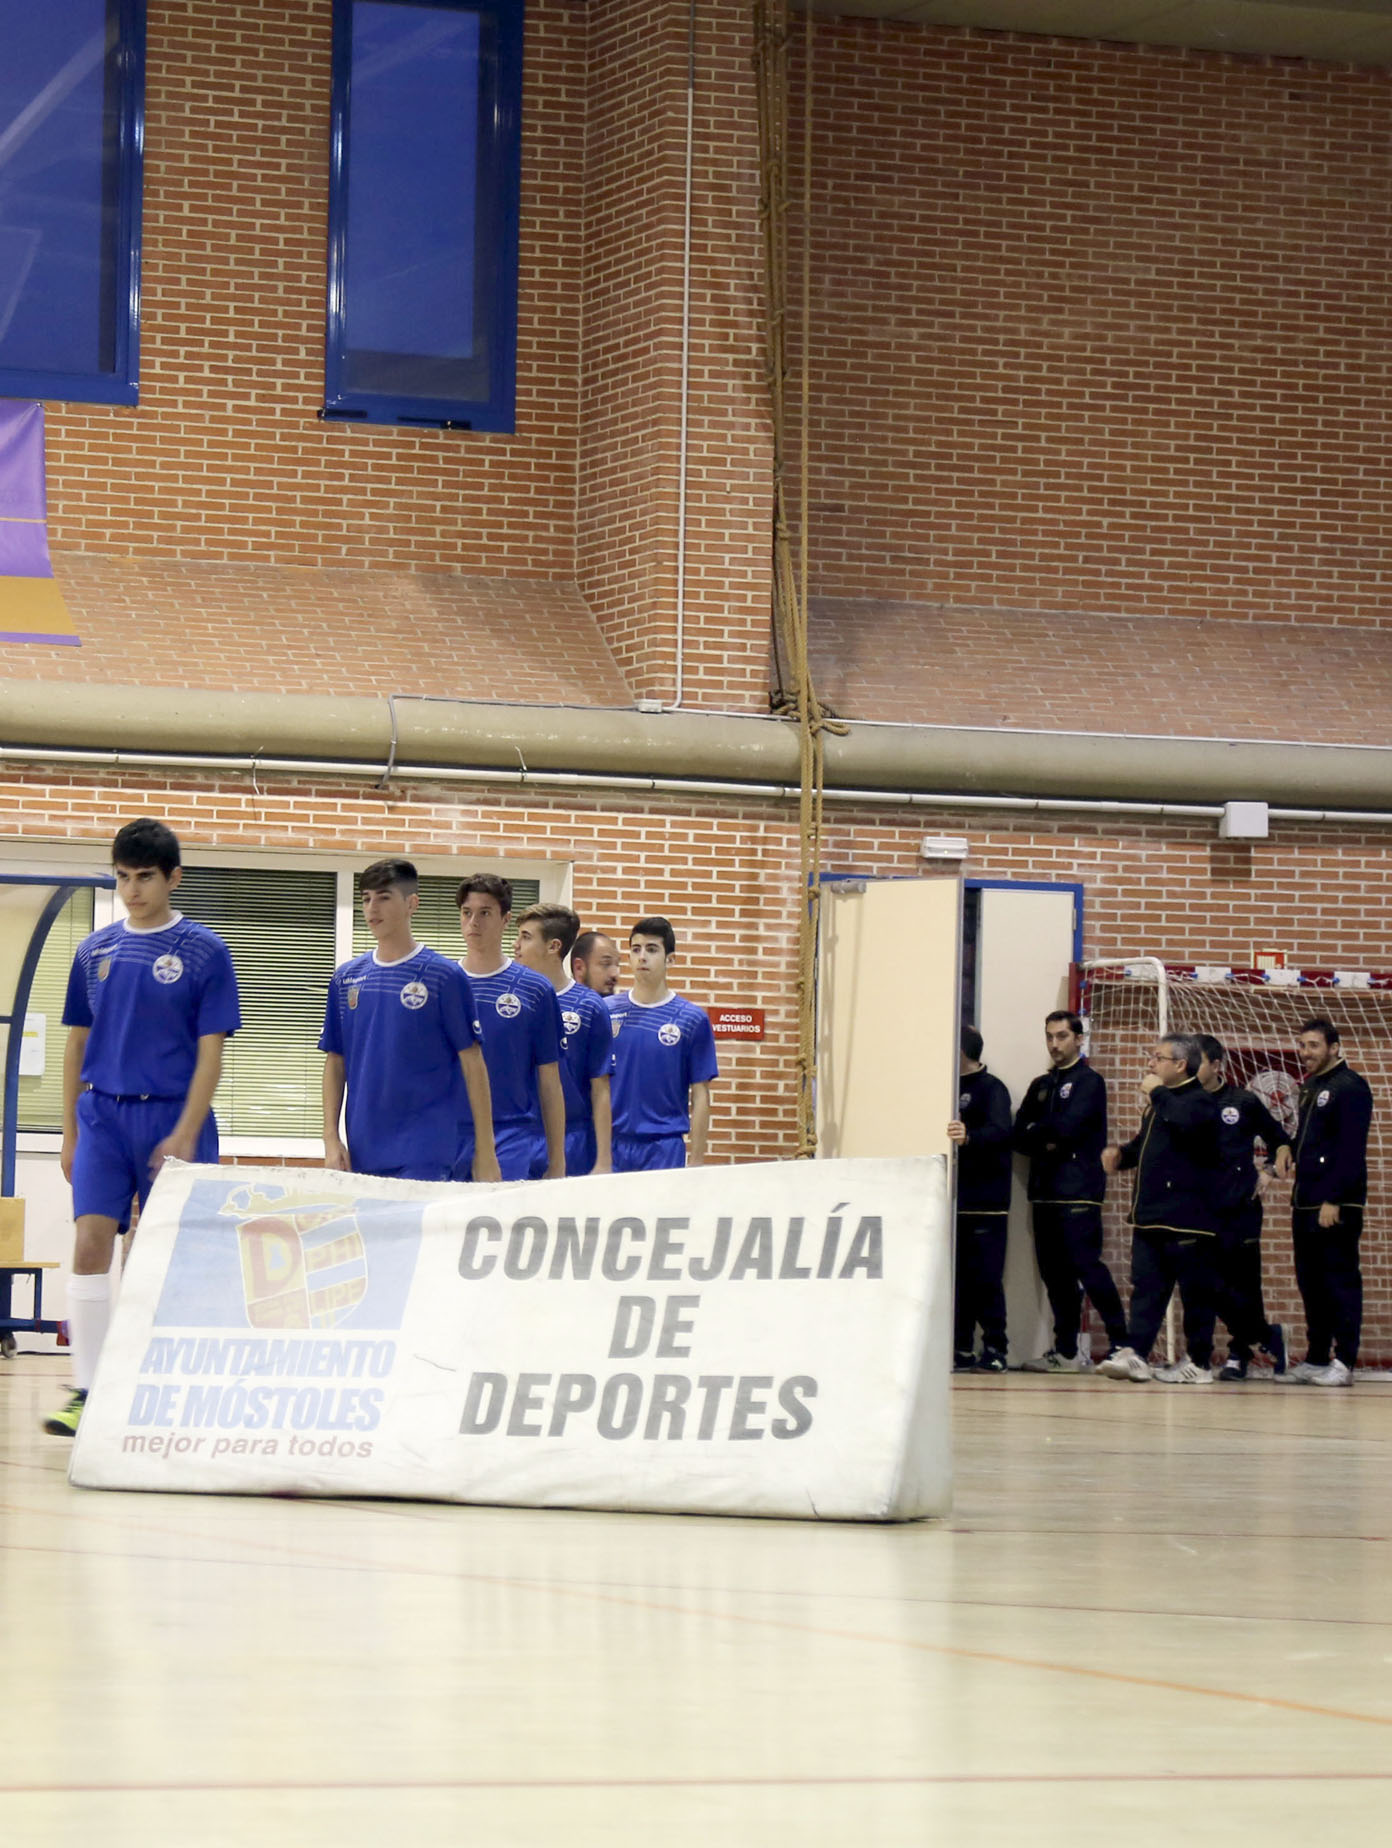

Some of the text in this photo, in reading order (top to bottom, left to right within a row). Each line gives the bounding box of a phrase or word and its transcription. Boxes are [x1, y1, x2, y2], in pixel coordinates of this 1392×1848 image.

[712, 1024, 760, 1033] VESTUARIOS
[719, 1014, 752, 1023] ACCESO
[458, 1202, 883, 1282] CONCEJALÍA
[608, 1295, 701, 1359] DE
[139, 1337, 397, 1379] AYUNTAMIENTO
[127, 1378, 385, 1432] DE MÓSTOLES
[459, 1372, 818, 1441] DEPORTES
[122, 1433, 373, 1460] mejor para todos
